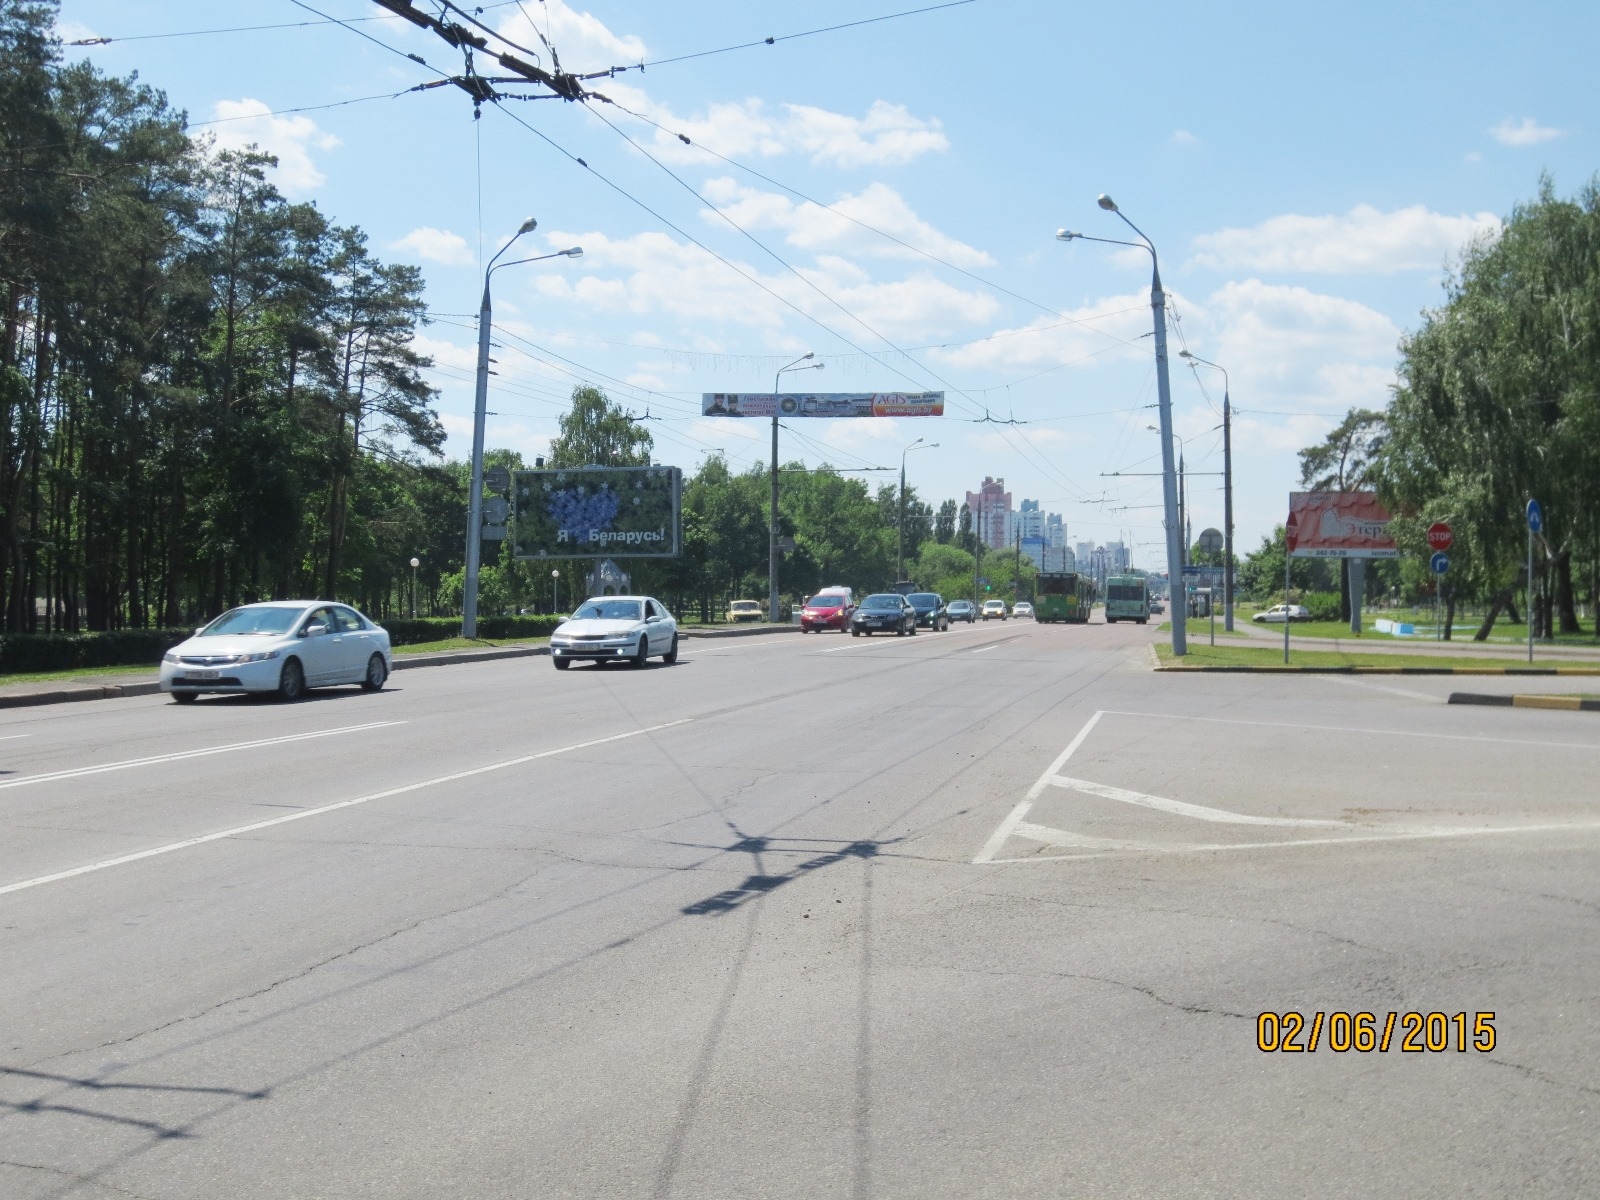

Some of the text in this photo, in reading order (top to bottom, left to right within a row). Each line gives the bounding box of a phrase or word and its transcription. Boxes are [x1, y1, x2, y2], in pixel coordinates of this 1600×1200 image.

[878, 393, 906, 404] AGIS
[885, 405, 932, 415] www.agis.by
[556, 527, 665, 545] Я Беларусь!
[1429, 532, 1451, 542] STOP
